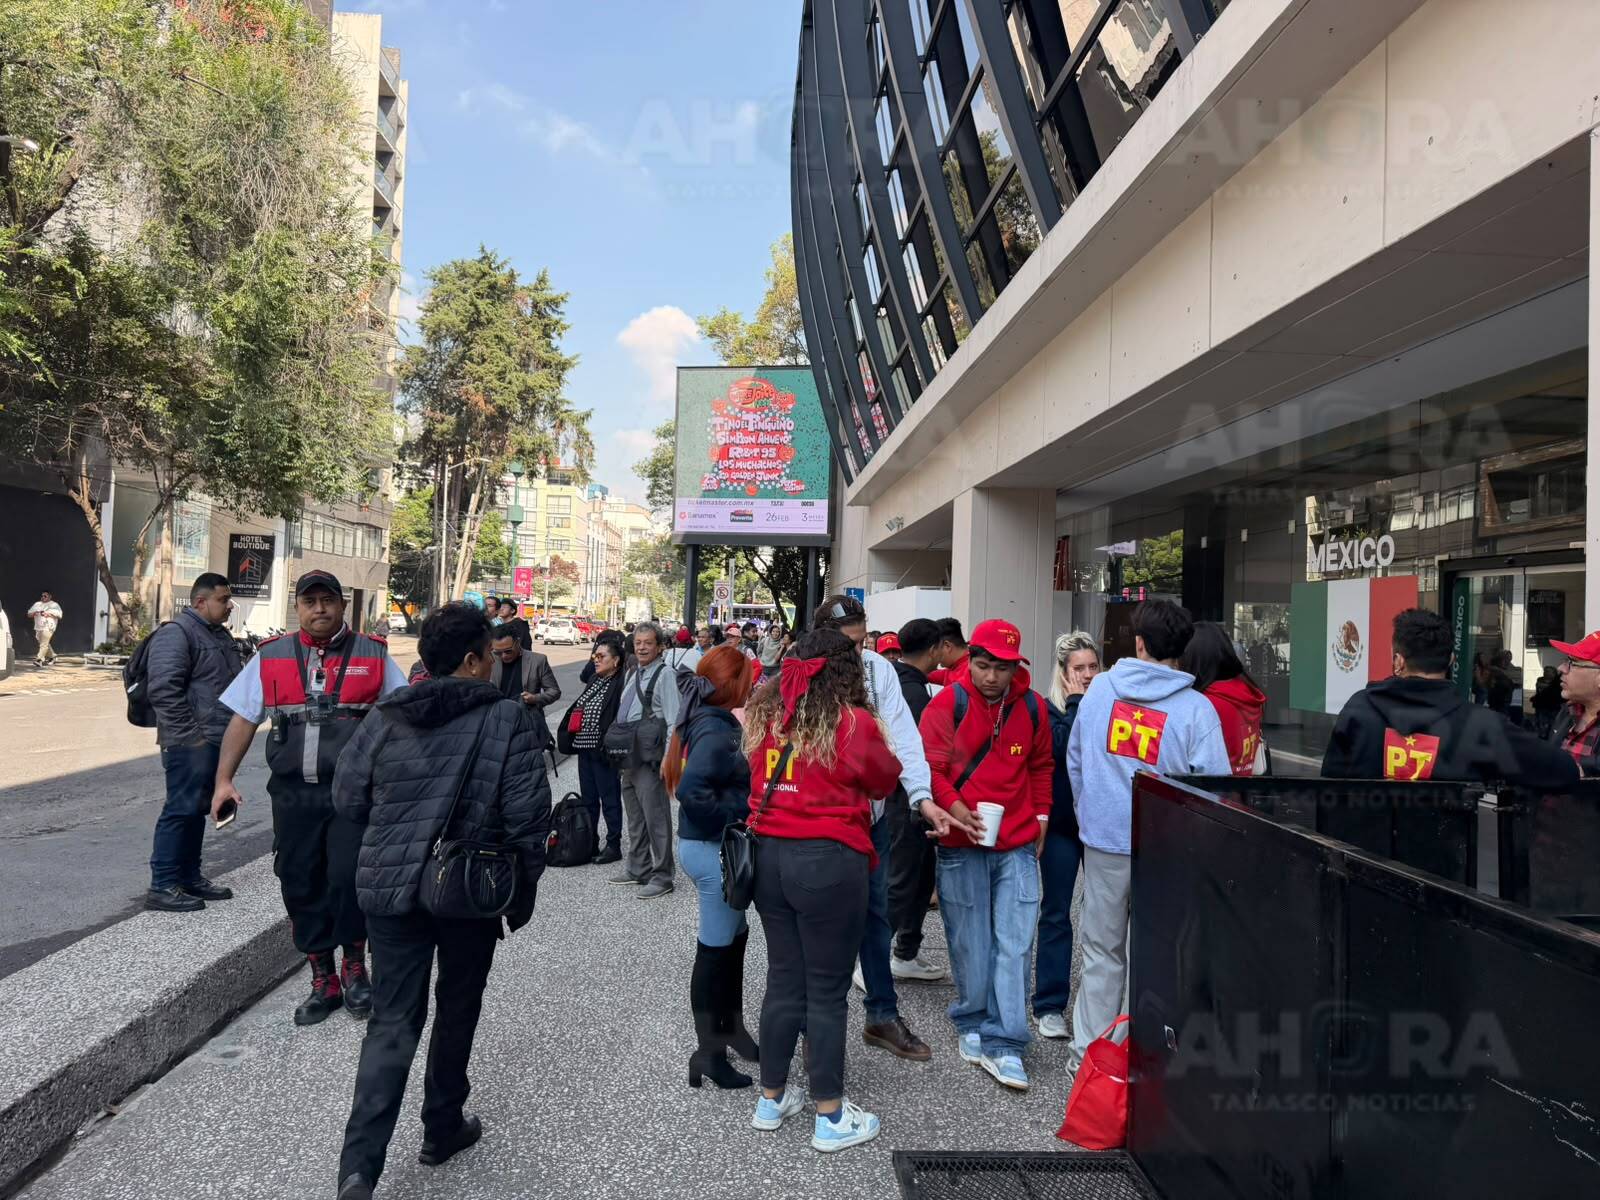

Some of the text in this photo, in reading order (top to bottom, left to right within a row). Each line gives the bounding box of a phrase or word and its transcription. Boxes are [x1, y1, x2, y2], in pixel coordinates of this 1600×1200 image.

[233, 542, 270, 550] BOUTIQUE
[1309, 534, 1395, 573] MÉXICO
[1453, 596, 1465, 651] MÉXICO
[1010, 746, 1022, 755] PT
[1110, 719, 1158, 760] PT
[1387, 745, 1433, 781] PT
